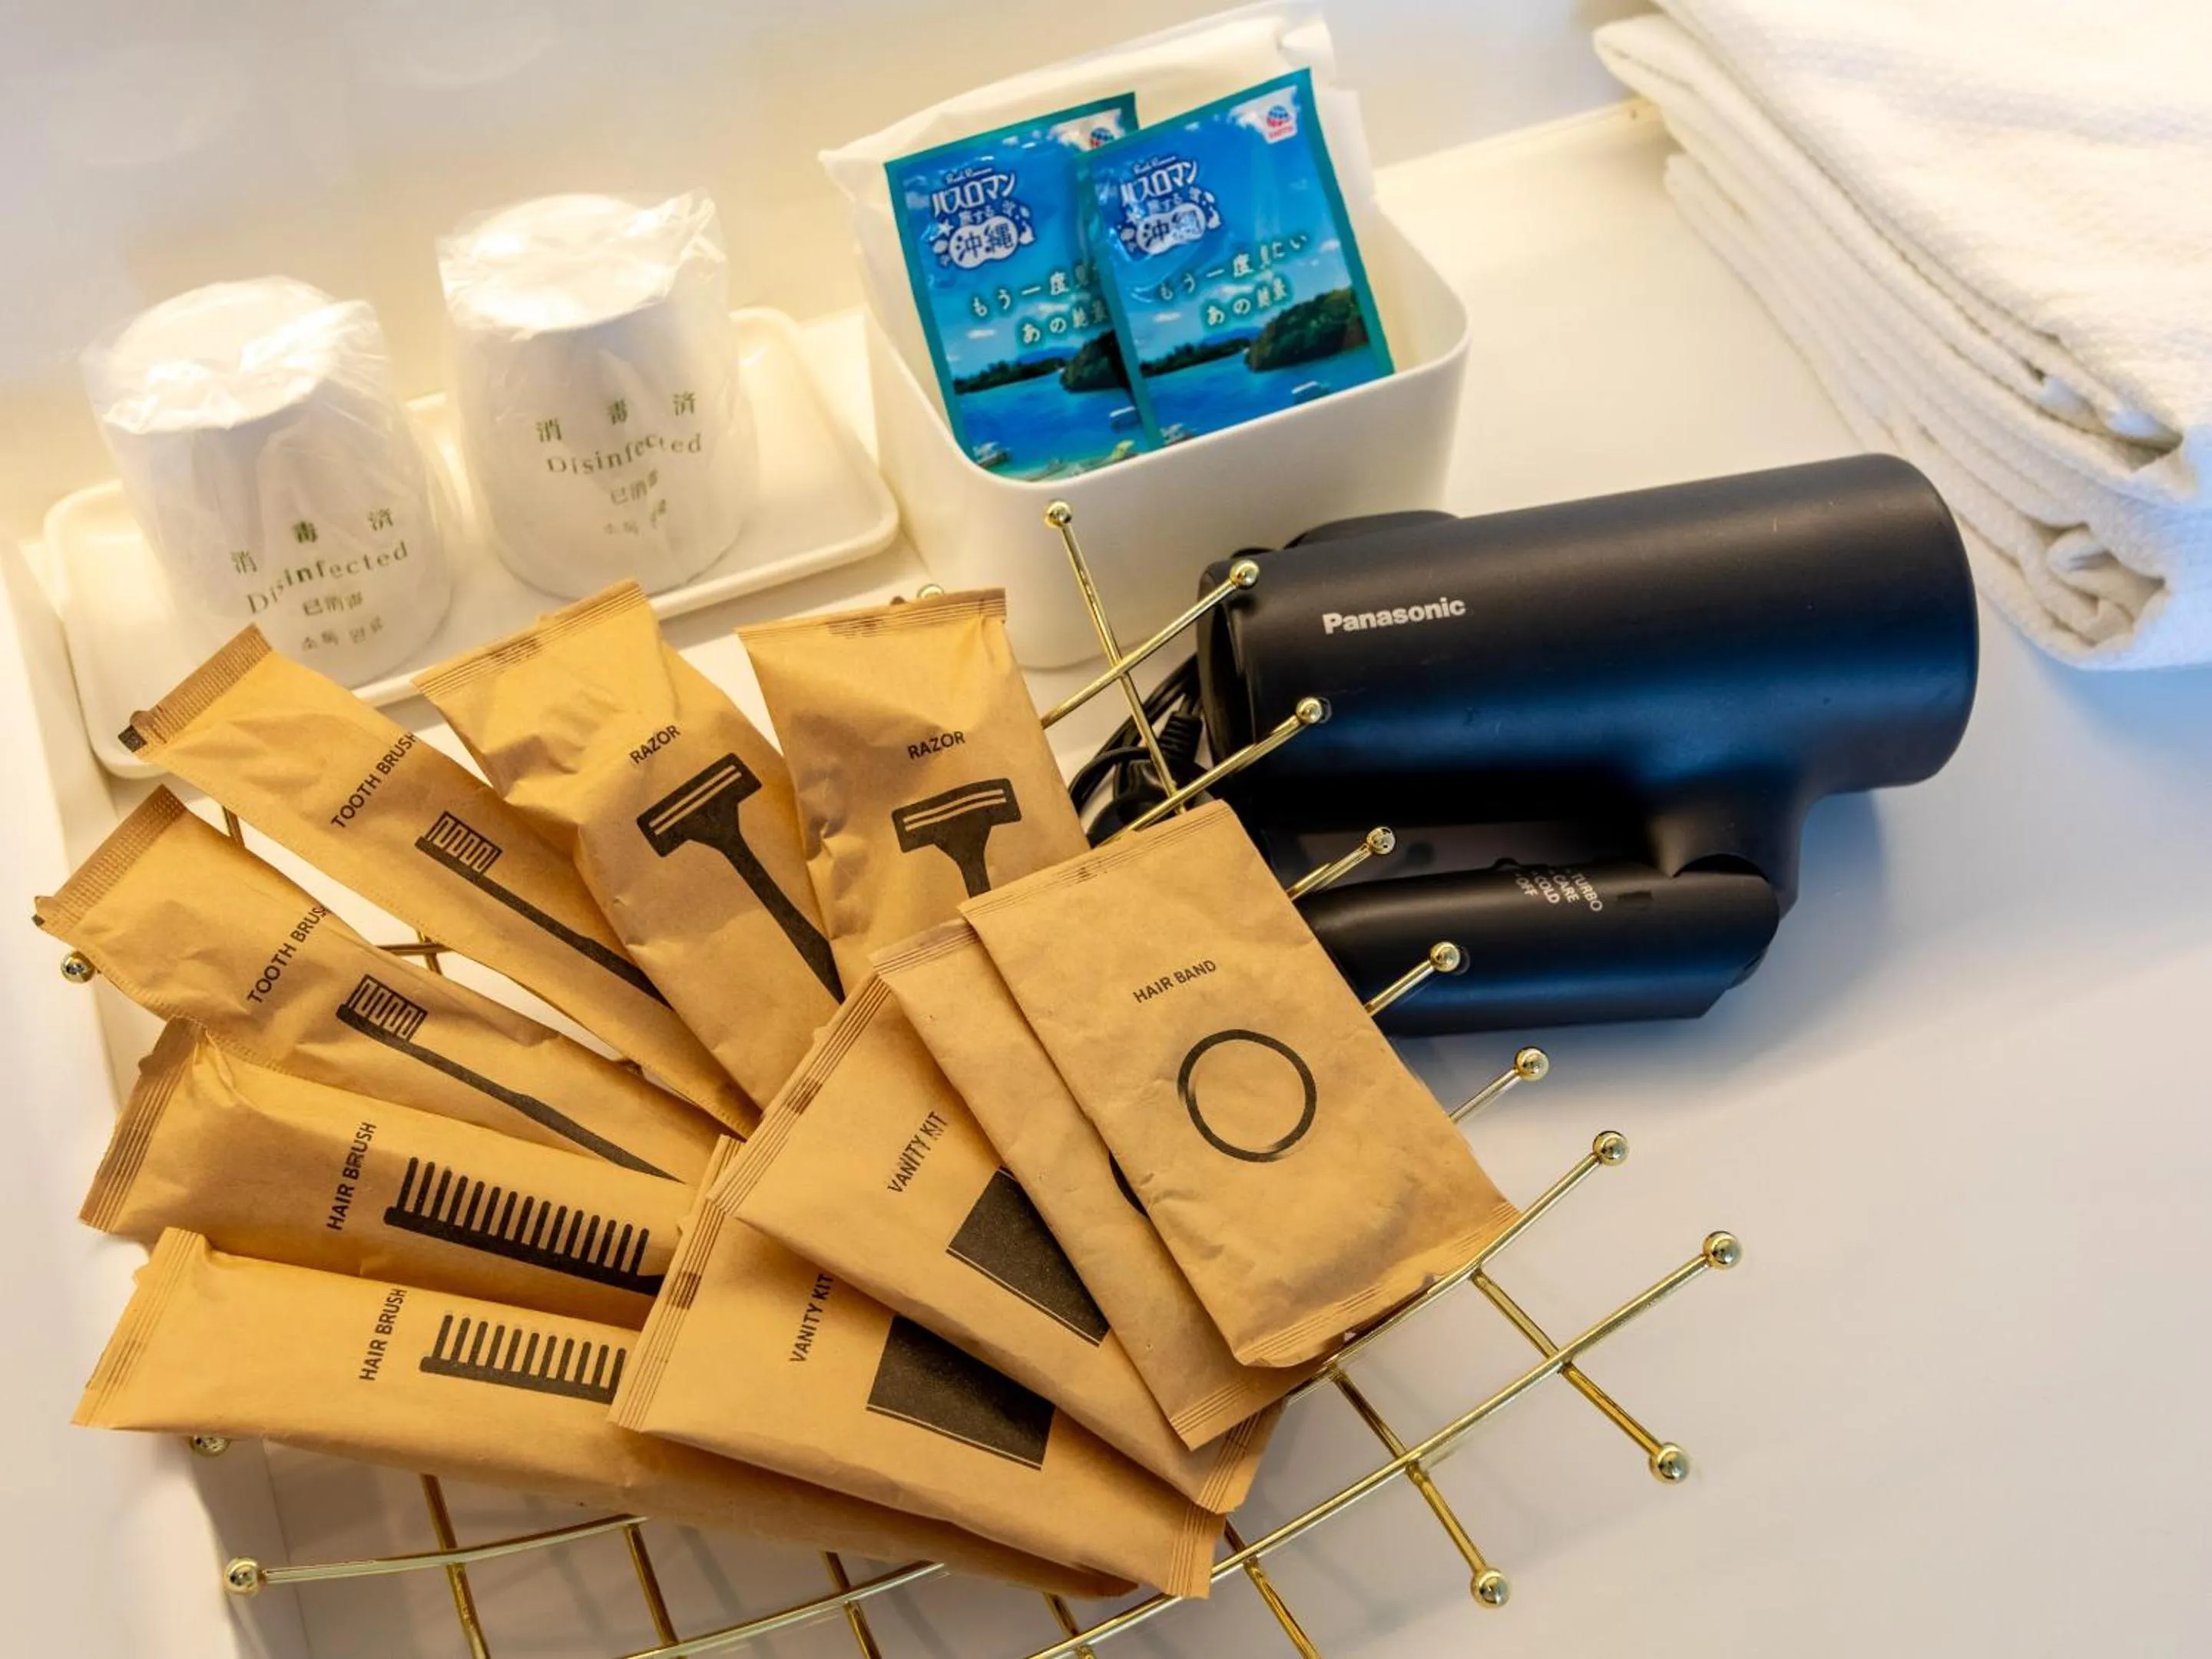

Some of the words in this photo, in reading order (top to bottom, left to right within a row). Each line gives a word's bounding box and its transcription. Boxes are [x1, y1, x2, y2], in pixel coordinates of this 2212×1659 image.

[546, 432, 702, 475] Disinfected
[247, 541, 409, 614] Disinfected
[1322, 597, 1466, 634] Panasonic
[629, 724, 681, 765] RAZOR
[906, 730, 965, 760] RAZOR
[330, 773, 382, 829] TOOTH
[1515, 877, 1538, 897] OFF
[1534, 876, 1561, 904] COLD
[1552, 874, 1579, 903] CARE
[1572, 873, 1603, 912] TURBO
[247, 942, 297, 1003] TOOTH
[290, 905, 329, 943] BRUS
[1132, 976, 1174, 1003] HAIR
[1173, 960, 1217, 984] BAND
[887, 1134, 931, 1193] VANITY
[919, 1111, 949, 1143] KIT
[326, 1183, 355, 1230] HAIR
[343, 1121, 377, 1181] BRUSH
[359, 1337, 388, 1381] HAIR
[375, 1288, 407, 1336] BRUSH
[790, 1303, 823, 1363] VANITY
[812, 1273, 835, 1301] KIT
